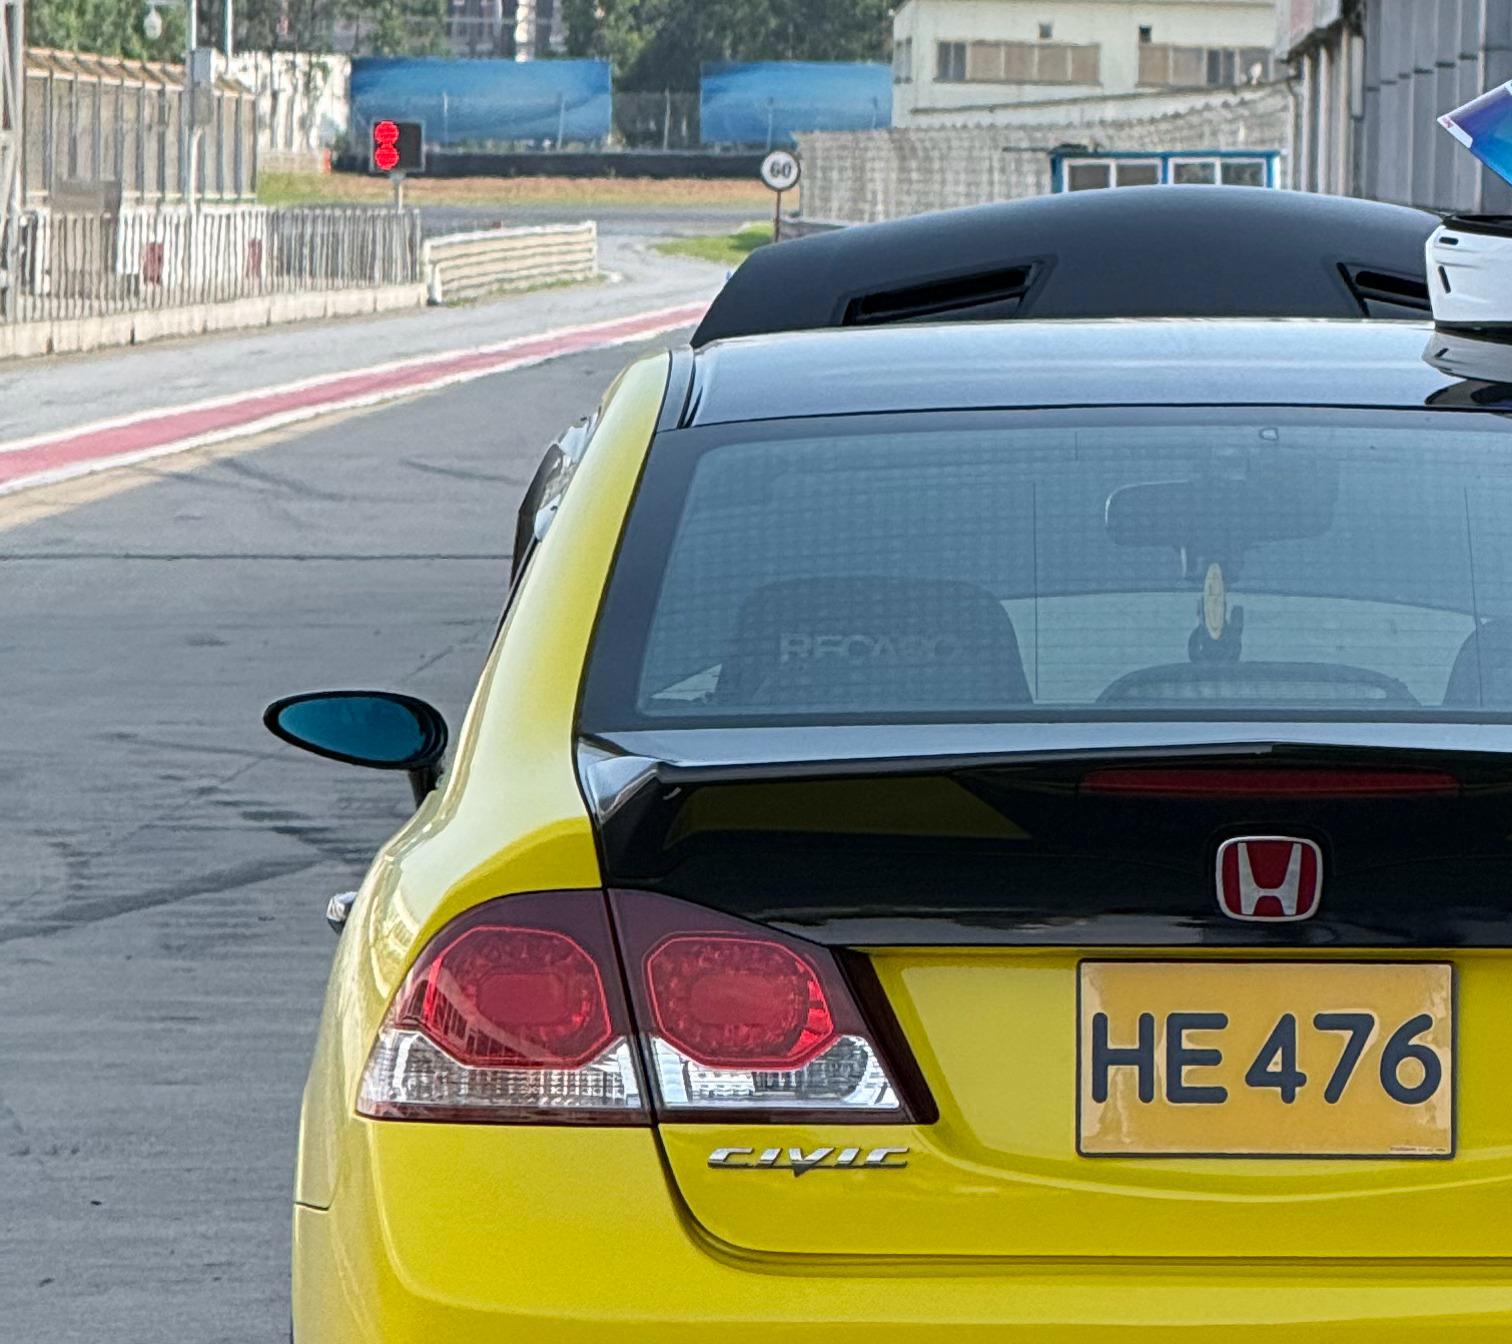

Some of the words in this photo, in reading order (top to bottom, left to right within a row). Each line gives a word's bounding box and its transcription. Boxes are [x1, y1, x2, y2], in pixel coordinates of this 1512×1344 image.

[770, 161, 792, 178] 60
[1092, 1012, 1228, 1104] HE
[1245, 1012, 1442, 1105] 476
[706, 1147, 910, 1177] CIVIC
